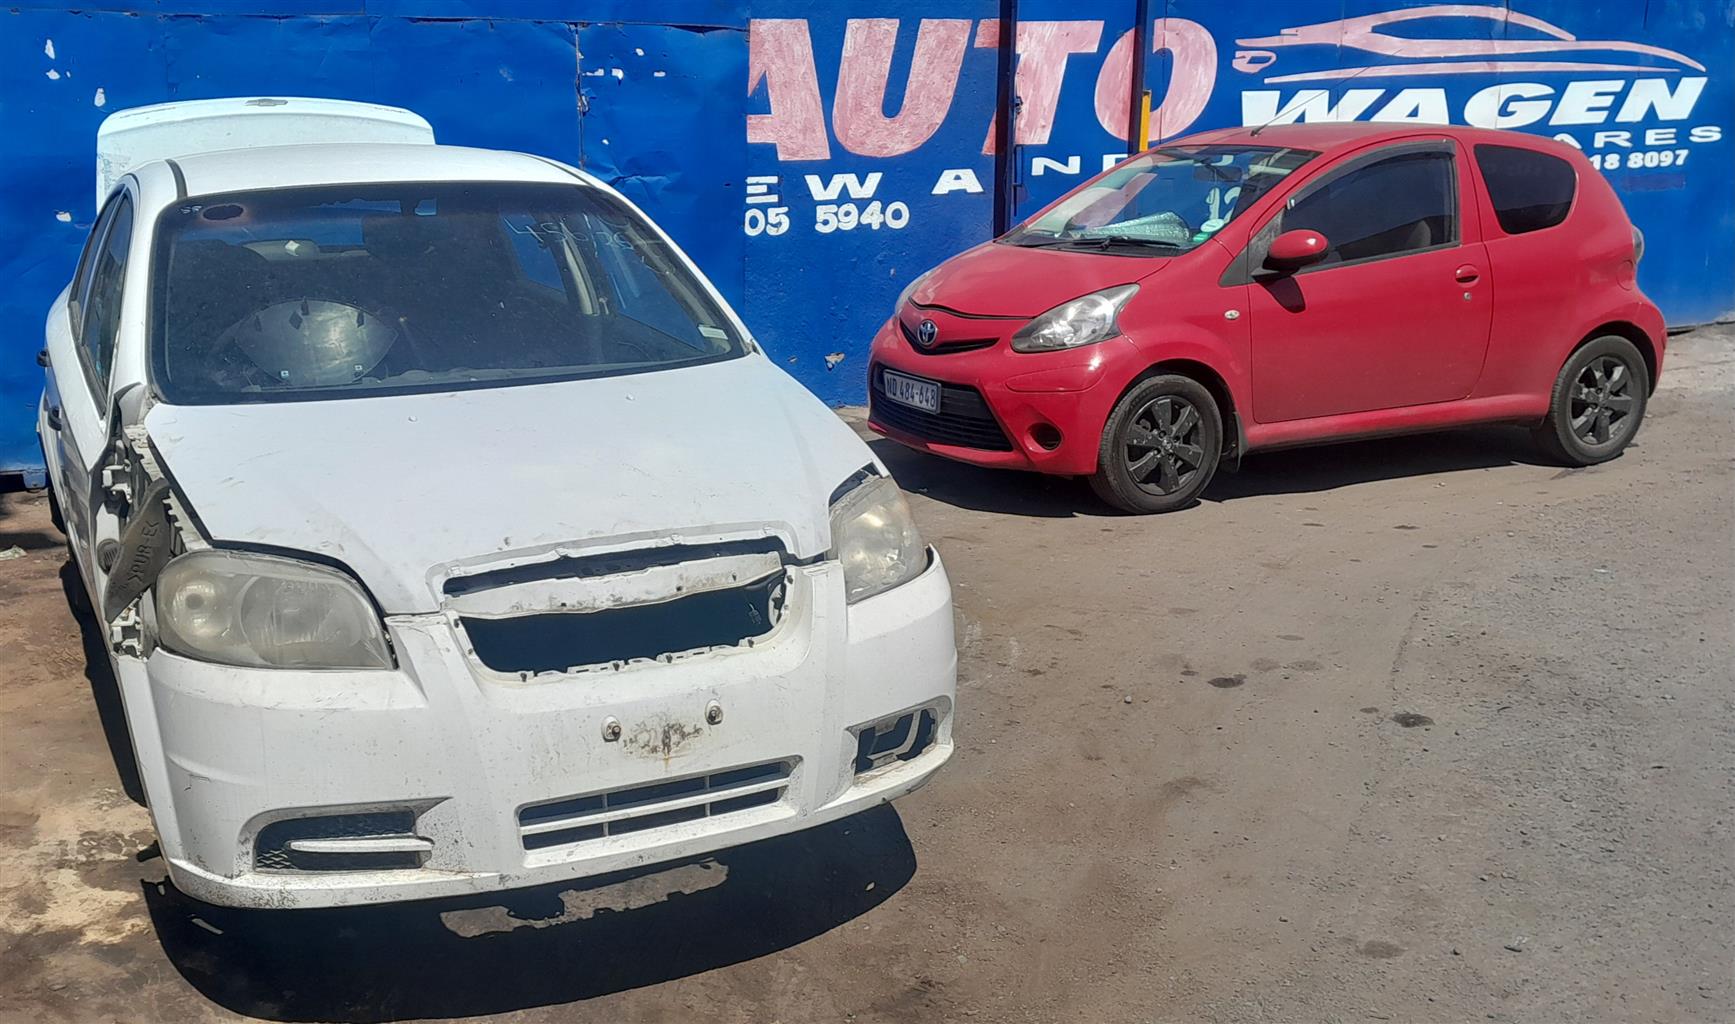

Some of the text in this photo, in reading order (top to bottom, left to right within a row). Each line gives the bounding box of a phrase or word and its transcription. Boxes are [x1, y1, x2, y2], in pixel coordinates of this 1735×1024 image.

[747, 18, 1218, 161] AUTO
[1242, 77, 1708, 128] WAGEN
[745, 206, 790, 237] 05
[814, 201, 911, 233] 5940
[1627, 150, 1690, 170] 8097
